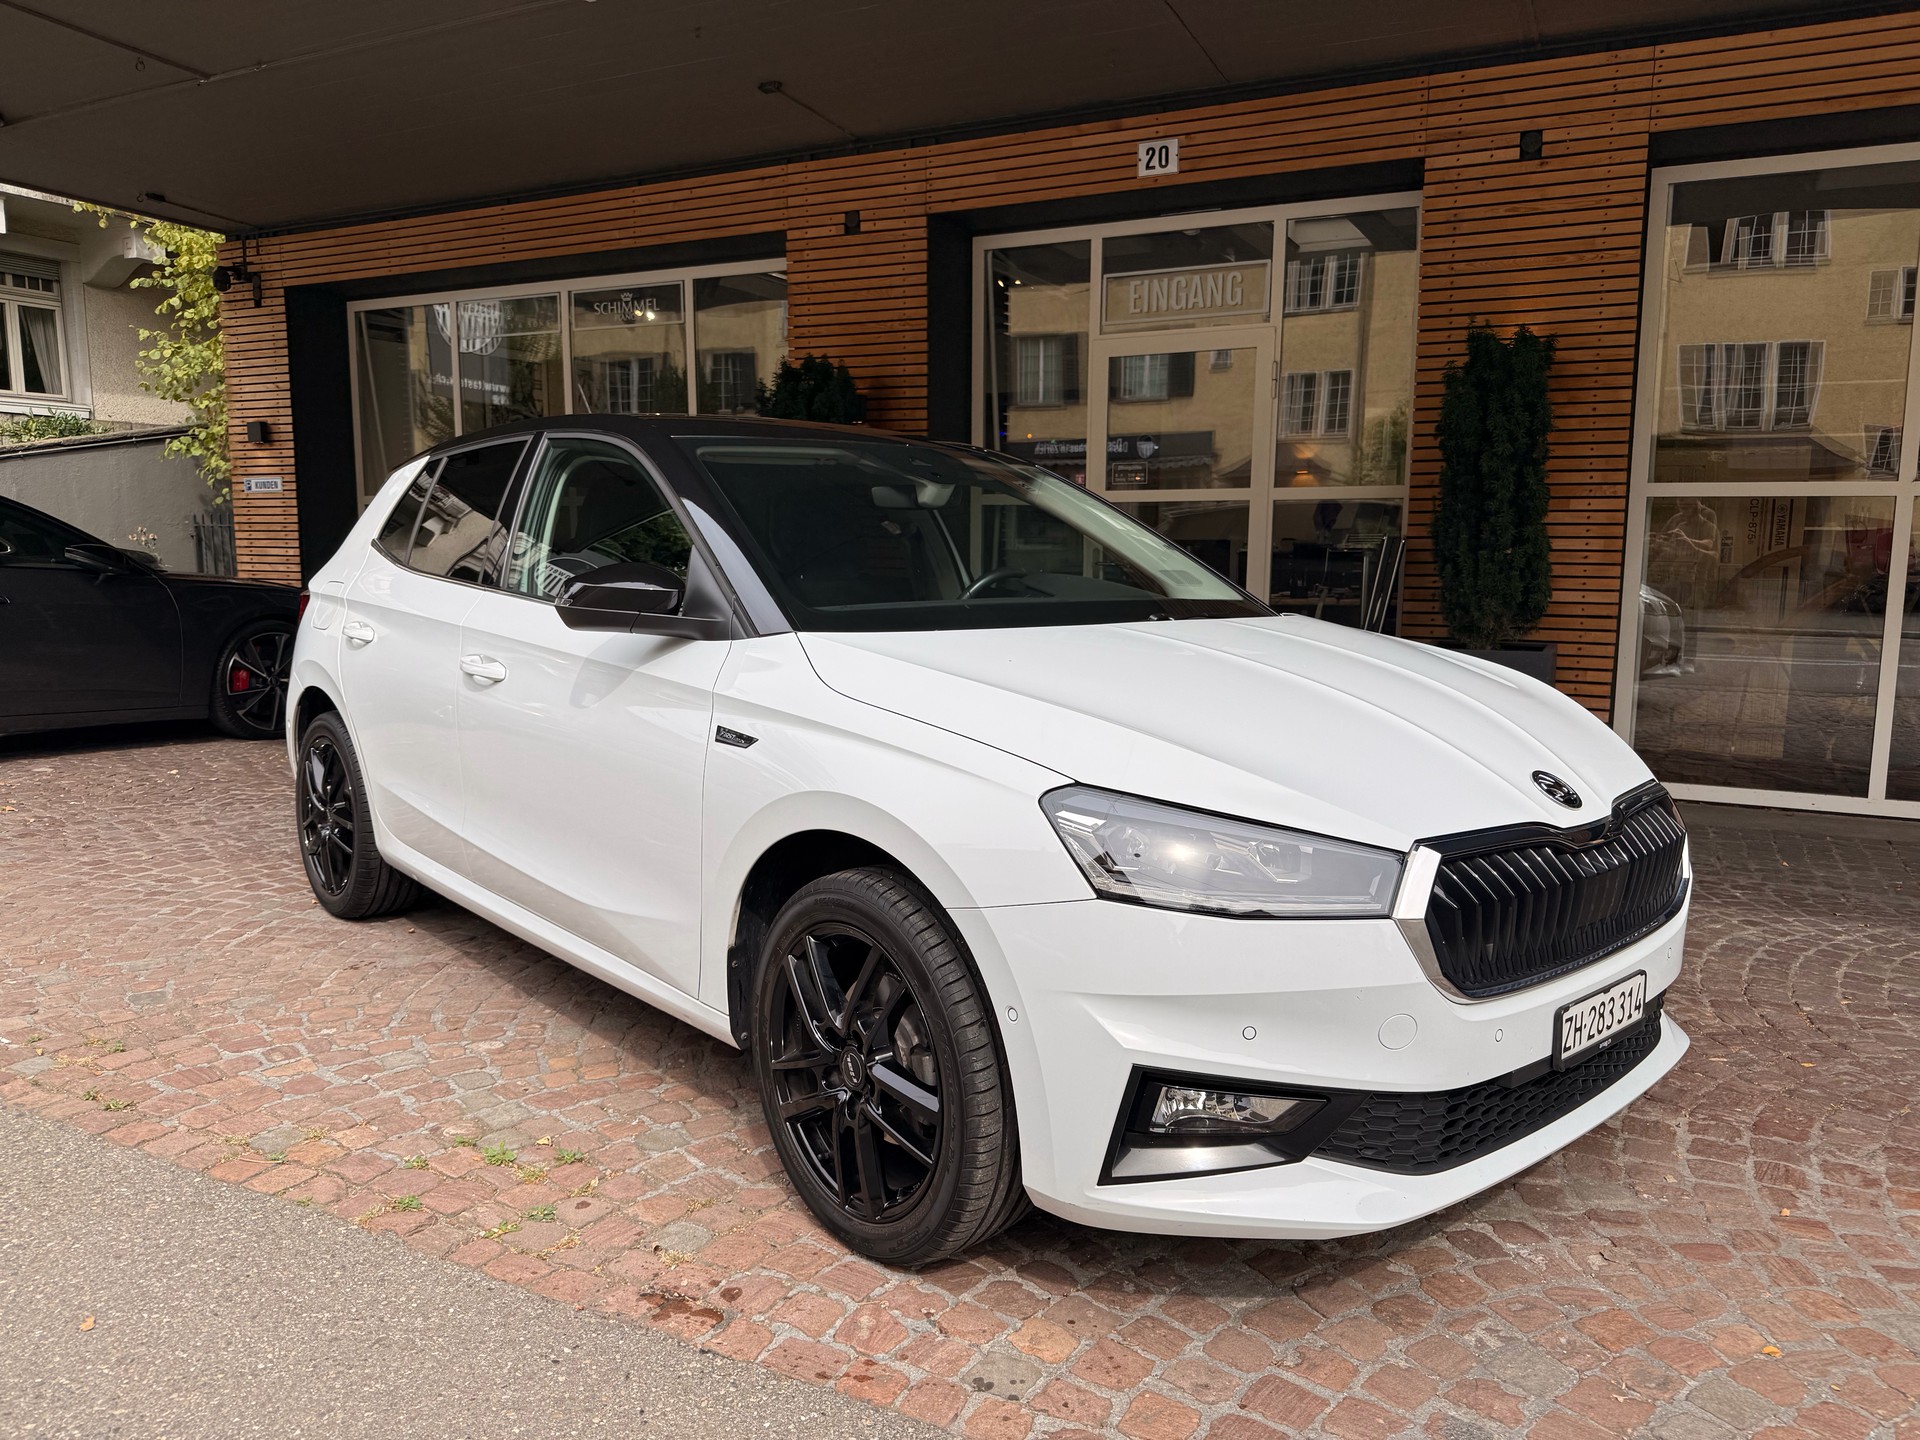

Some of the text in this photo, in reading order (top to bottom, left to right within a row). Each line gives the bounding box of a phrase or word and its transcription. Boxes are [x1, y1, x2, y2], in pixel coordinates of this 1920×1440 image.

[1145, 145, 1169, 170] 20
[1128, 270, 1244, 314] EINGANG
[593, 298, 660, 316] SCHIMMEL
[255, 481, 279, 490] KUNDEN
[1774, 514, 1788, 546] YAMAHA
